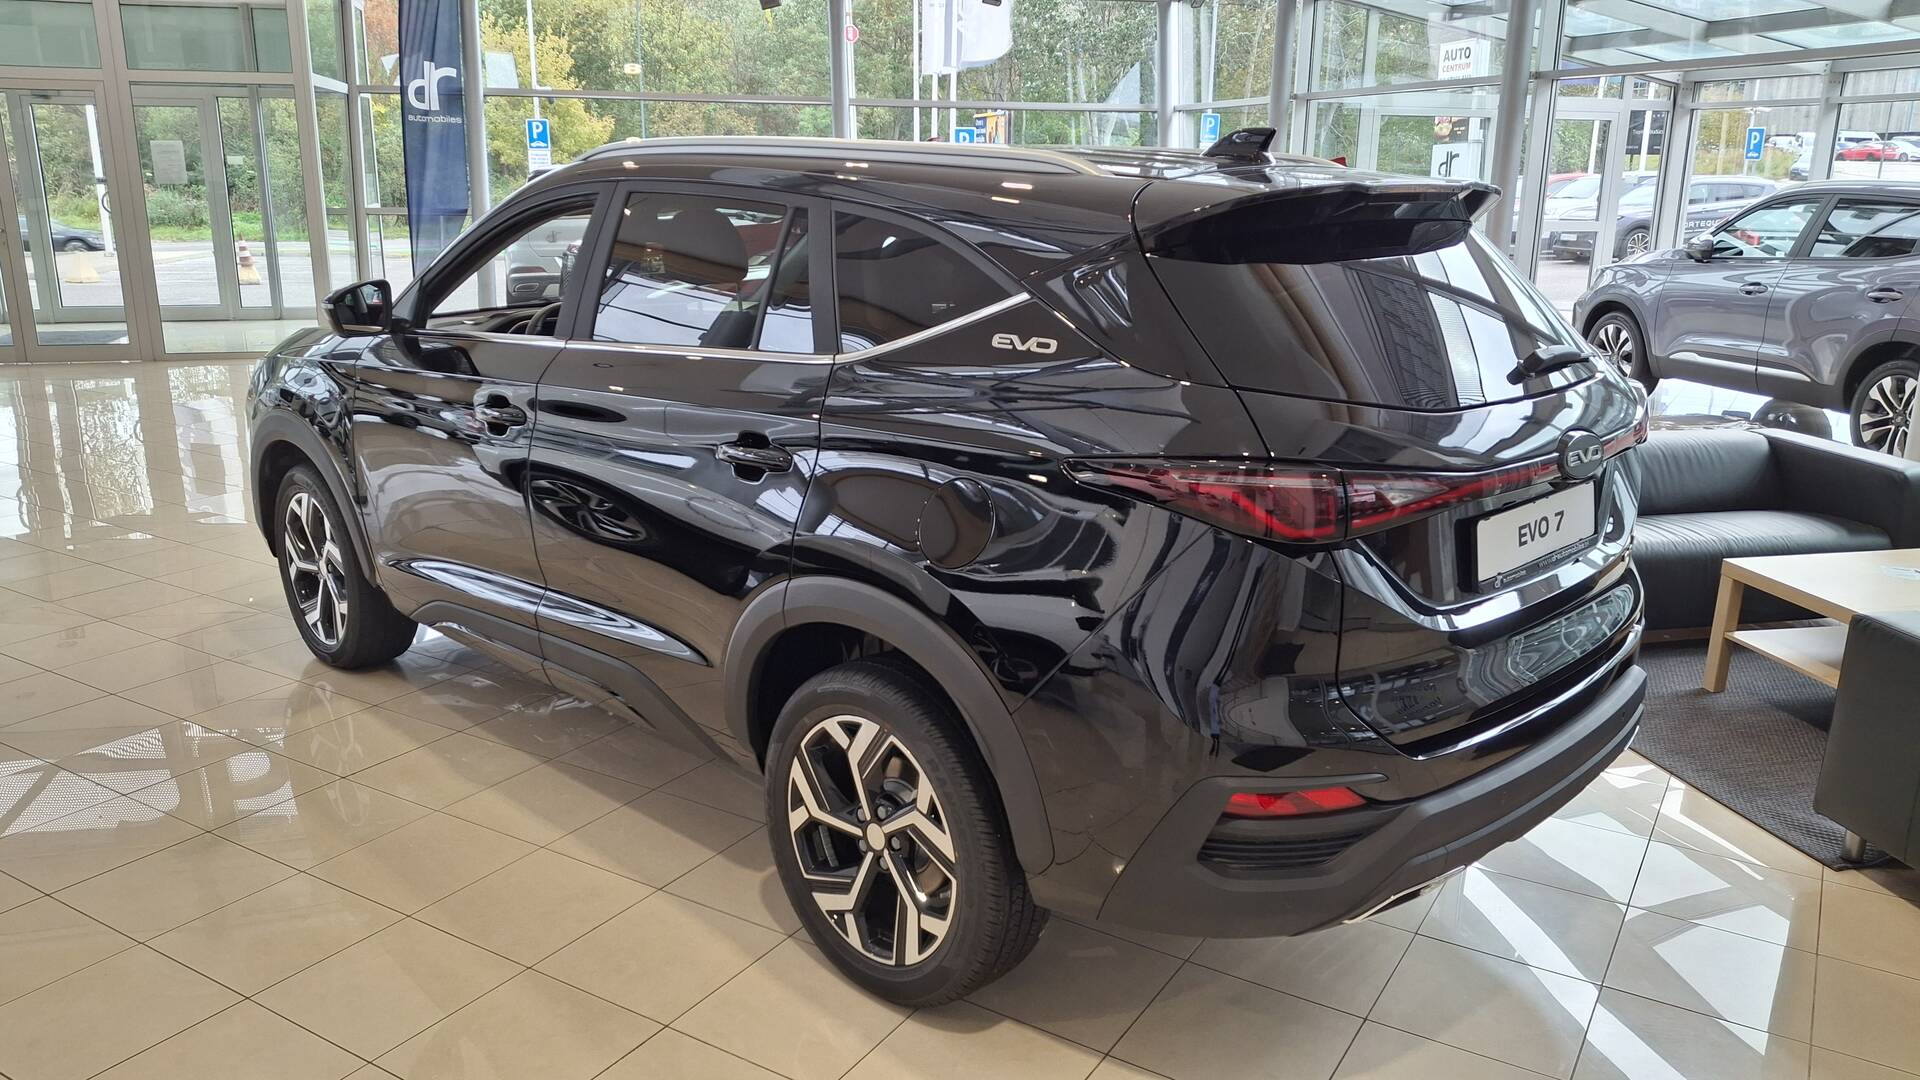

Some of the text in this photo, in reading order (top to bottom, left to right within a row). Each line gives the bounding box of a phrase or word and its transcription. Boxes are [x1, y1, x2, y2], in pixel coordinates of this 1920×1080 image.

[1443, 46, 1472, 62] AUTO
[1442, 62, 1472, 73] CENTRUM
[407, 60, 457, 111] dr
[407, 114, 463, 124] automobiles
[1206, 117, 1216, 134] P
[532, 121, 544, 139] P
[1750, 131, 1760, 150] P
[991, 333, 1058, 354] EVO
[1567, 444, 1601, 467] EVO
[1518, 509, 1565, 548] EVO 7
